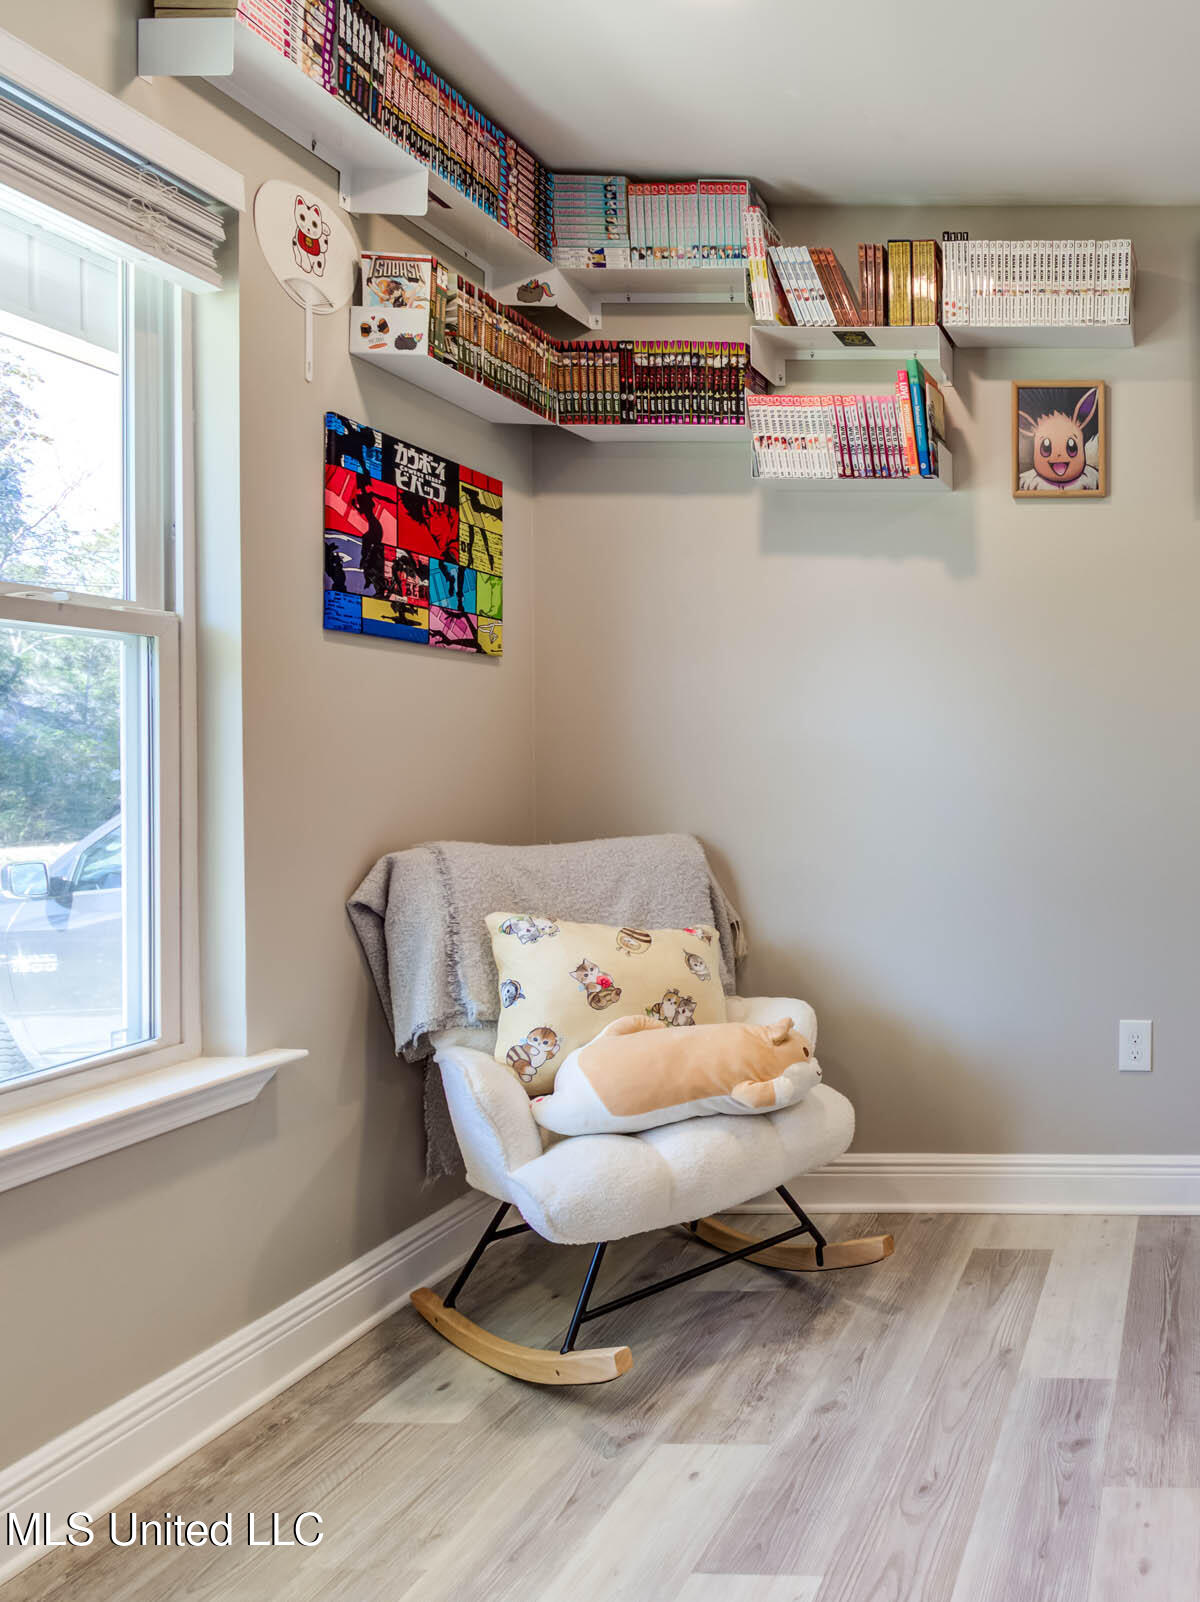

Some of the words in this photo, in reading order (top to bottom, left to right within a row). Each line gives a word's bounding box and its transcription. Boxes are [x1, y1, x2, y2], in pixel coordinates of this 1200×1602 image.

[393, 442, 447, 481] カウボーイ
[394, 468, 447, 503] ビバップ
